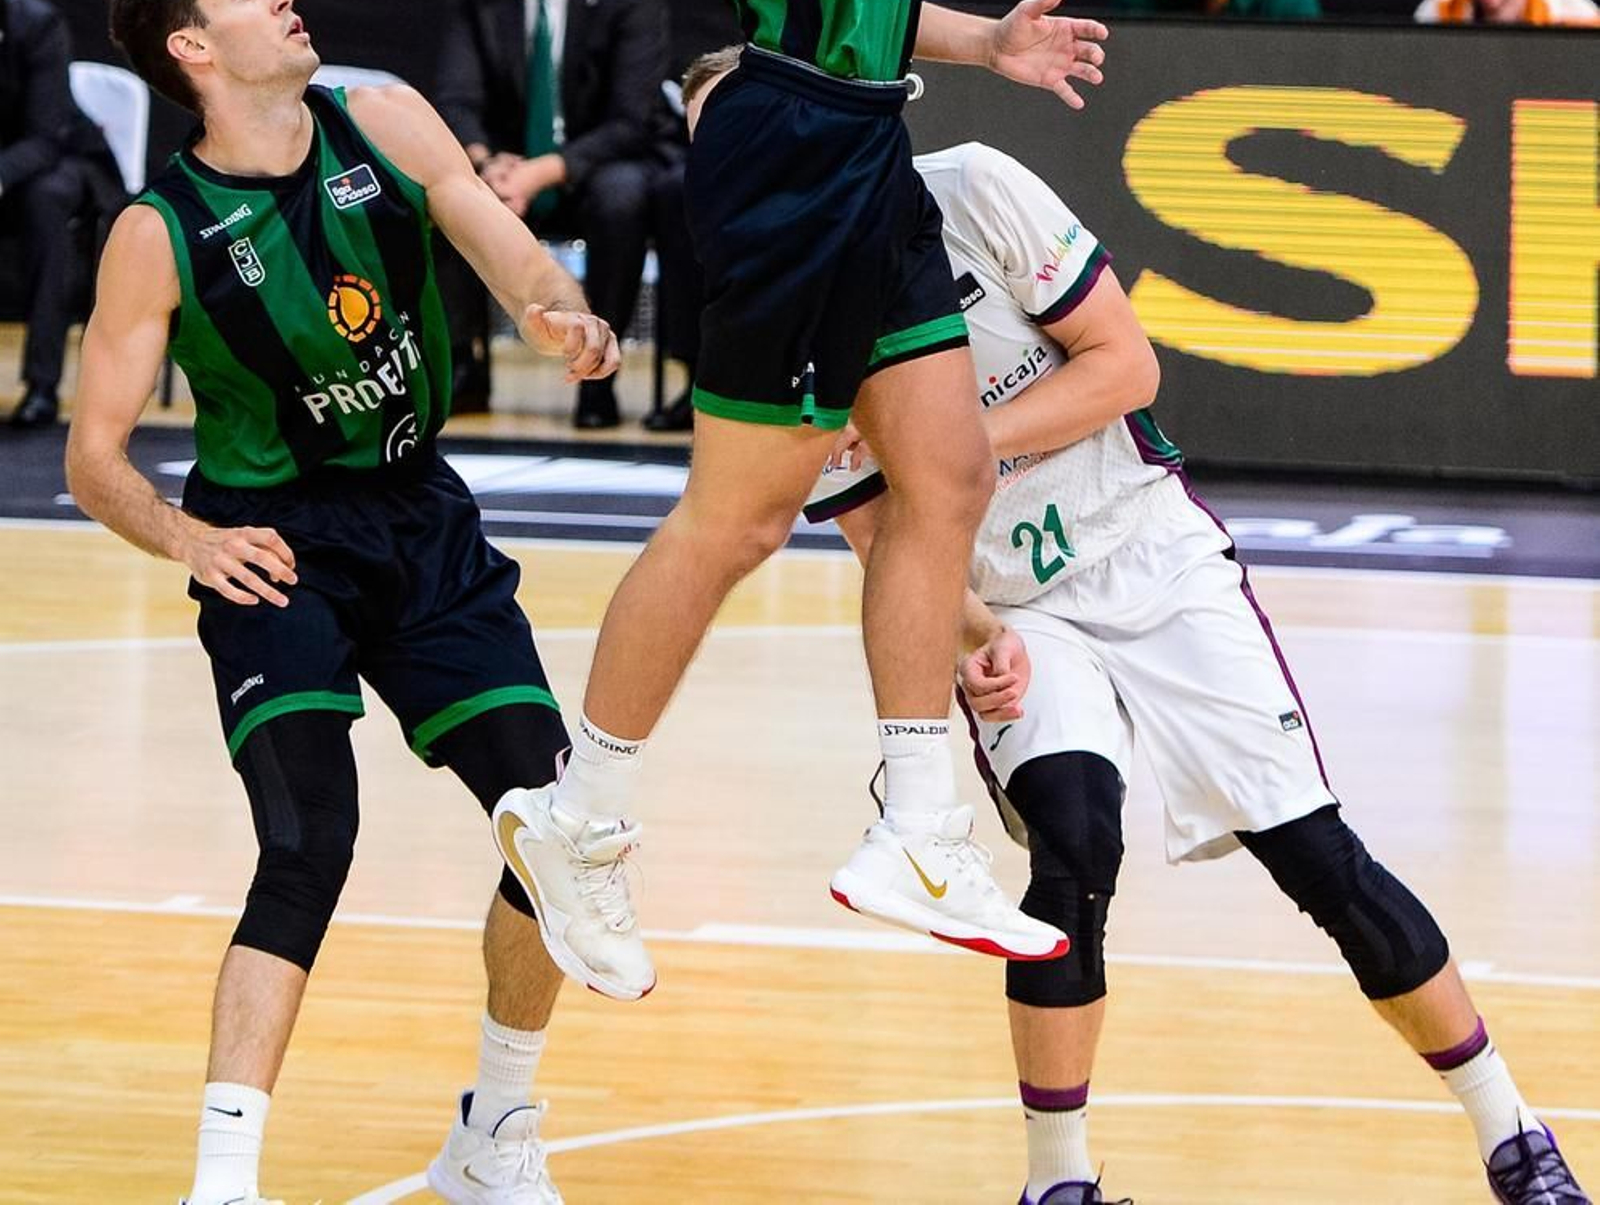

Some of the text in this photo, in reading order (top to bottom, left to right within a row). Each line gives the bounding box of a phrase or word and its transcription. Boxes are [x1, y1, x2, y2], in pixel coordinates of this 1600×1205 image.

[199, 203, 253, 239] SPALDING
[979, 345, 1049, 408] nicaja
[1011, 503, 1075, 585] 21
